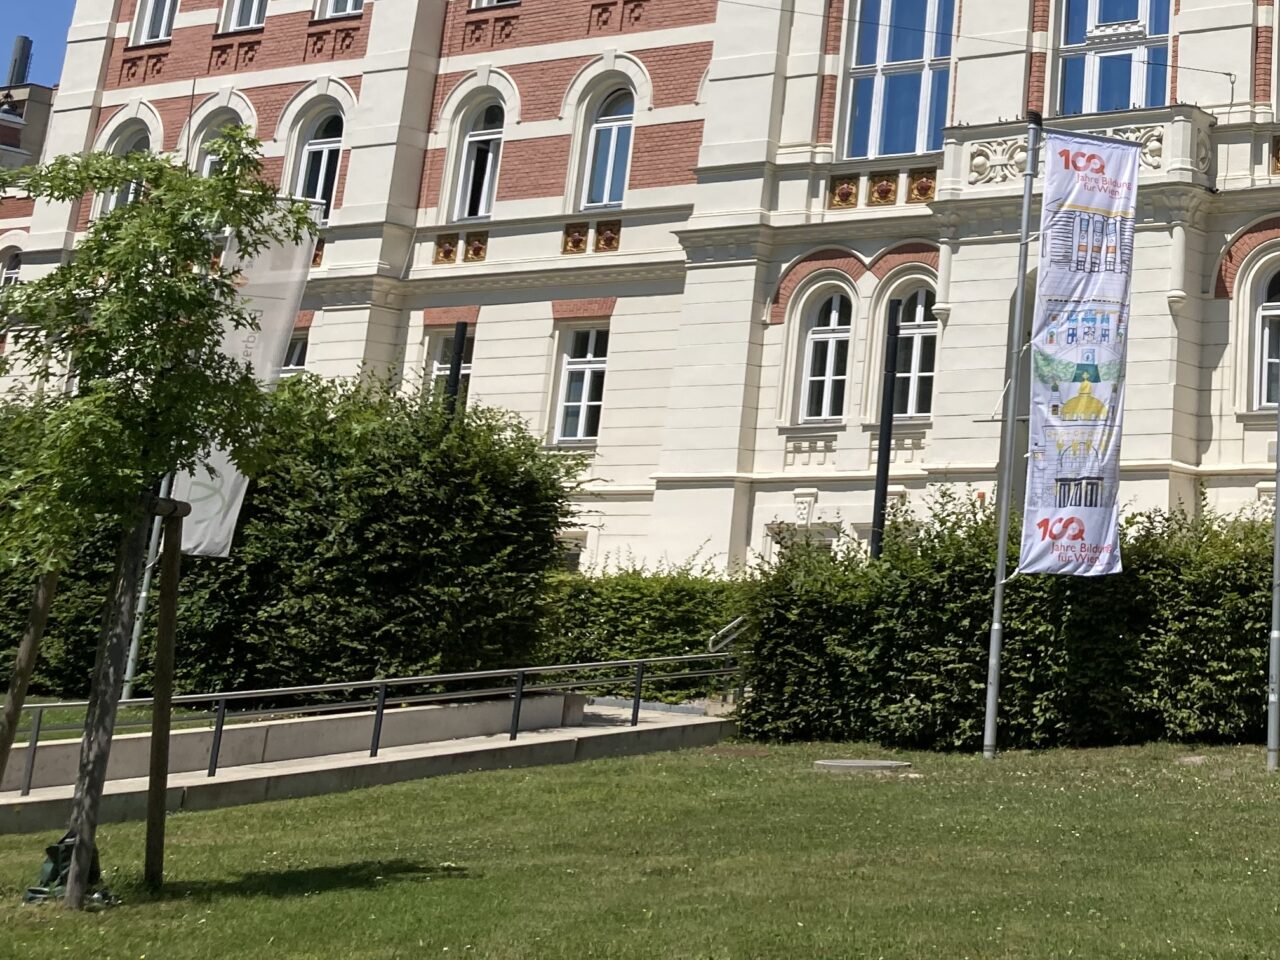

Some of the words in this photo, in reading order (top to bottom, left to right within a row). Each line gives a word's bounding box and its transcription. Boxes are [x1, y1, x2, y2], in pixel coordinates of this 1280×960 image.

[1076, 172, 1099, 184] Jahre
[1101, 176, 1132, 191] Bildung
[1097, 184, 1120, 197] Wien
[1051, 542, 1076, 554] Jahre
